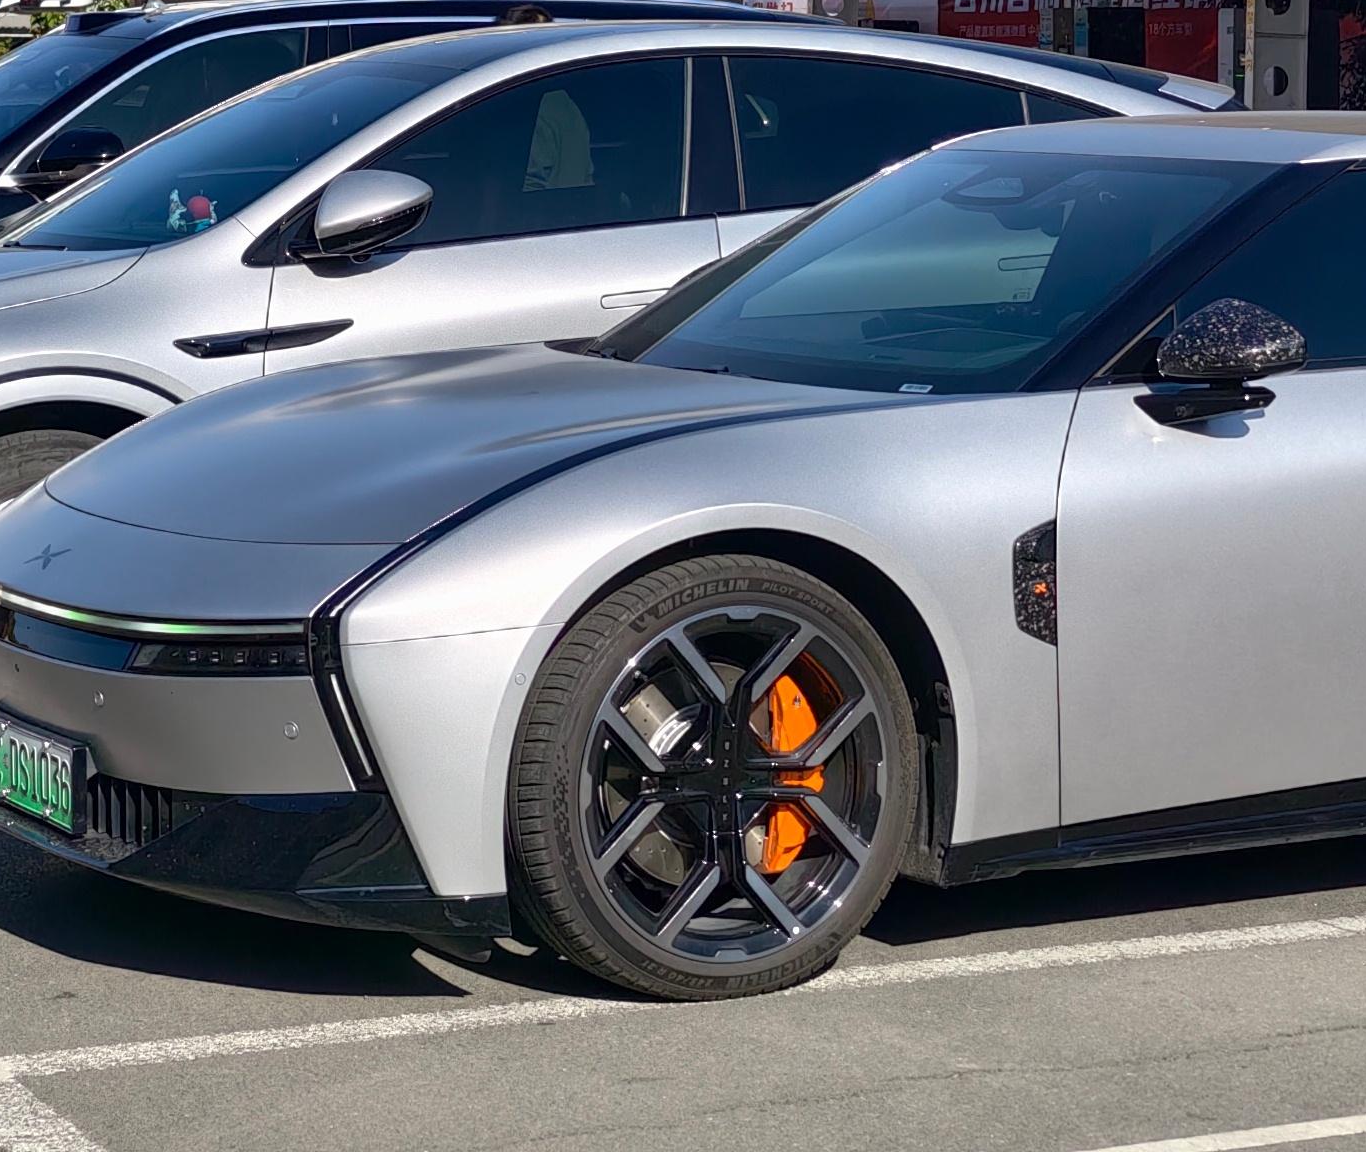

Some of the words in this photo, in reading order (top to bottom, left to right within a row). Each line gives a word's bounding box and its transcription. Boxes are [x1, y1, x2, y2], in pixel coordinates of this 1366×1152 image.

[657, 579, 750, 617] MICHELIN
[762, 581, 796, 596] PILOT
[796, 590, 836, 615] SPORT
